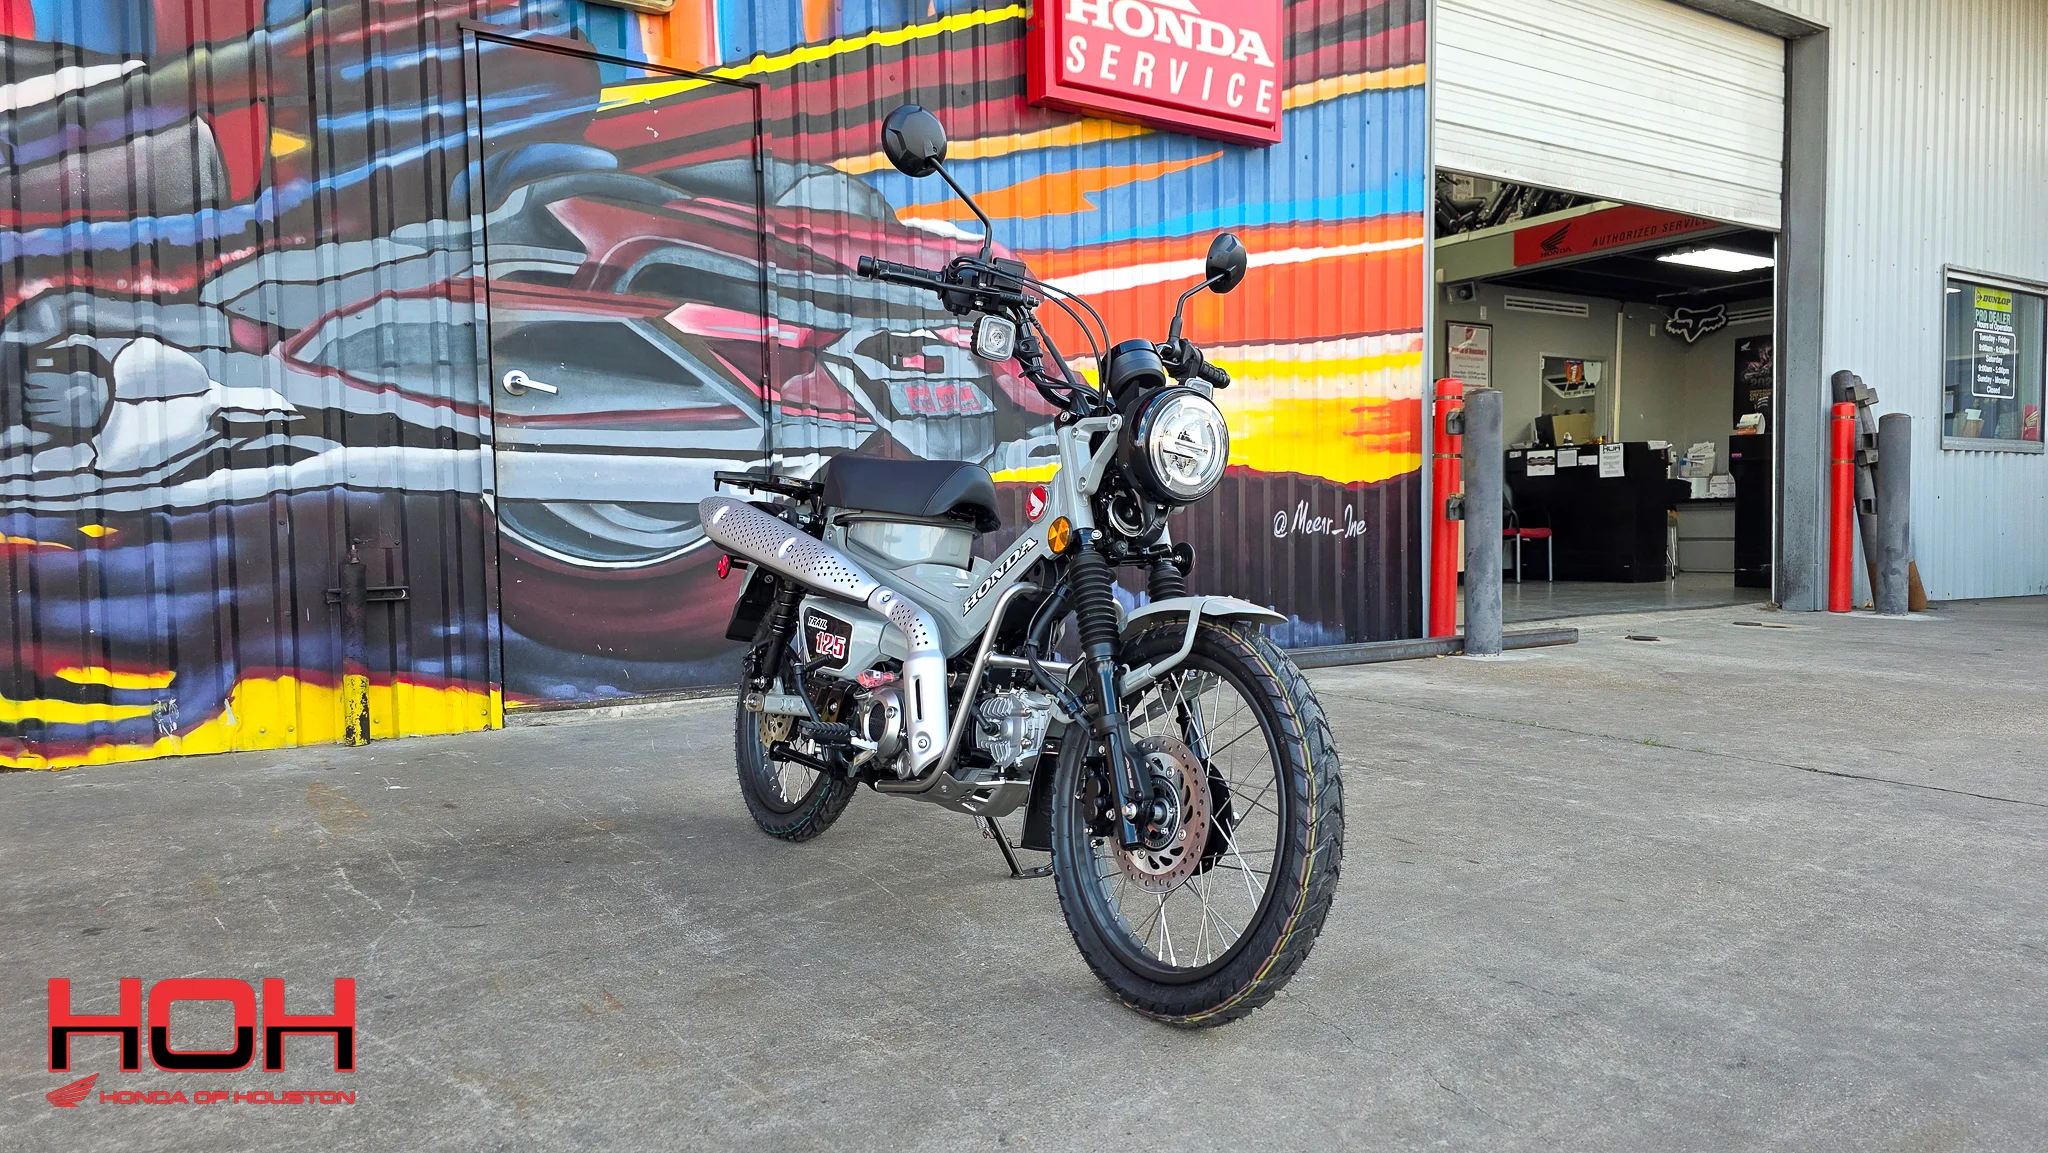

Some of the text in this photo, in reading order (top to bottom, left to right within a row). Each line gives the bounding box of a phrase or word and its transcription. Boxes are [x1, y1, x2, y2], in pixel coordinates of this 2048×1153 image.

[1065, 0, 1275, 68] HONDA
[1065, 35, 1275, 115] SERVICE
[1592, 226, 1657, 248] AUTHORIZED
[1540, 247, 1573, 258] HONDA
[1982, 294, 2012, 306] DUNLOP
[1975, 309, 2011, 326] PRO DEALER
[1994, 323, 2013, 333] Operation
[1997, 335, 2011, 346] Friday
[1985, 354, 2003, 366] Saturday
[1977, 374, 1992, 385] Sunday
[1994, 375, 2010, 387] Monday
[1986, 385, 2001, 395] Closed
[963, 537, 1039, 618] HONDA
[807, 615, 829, 631] TRAIL
[815, 631, 847, 660] 125
